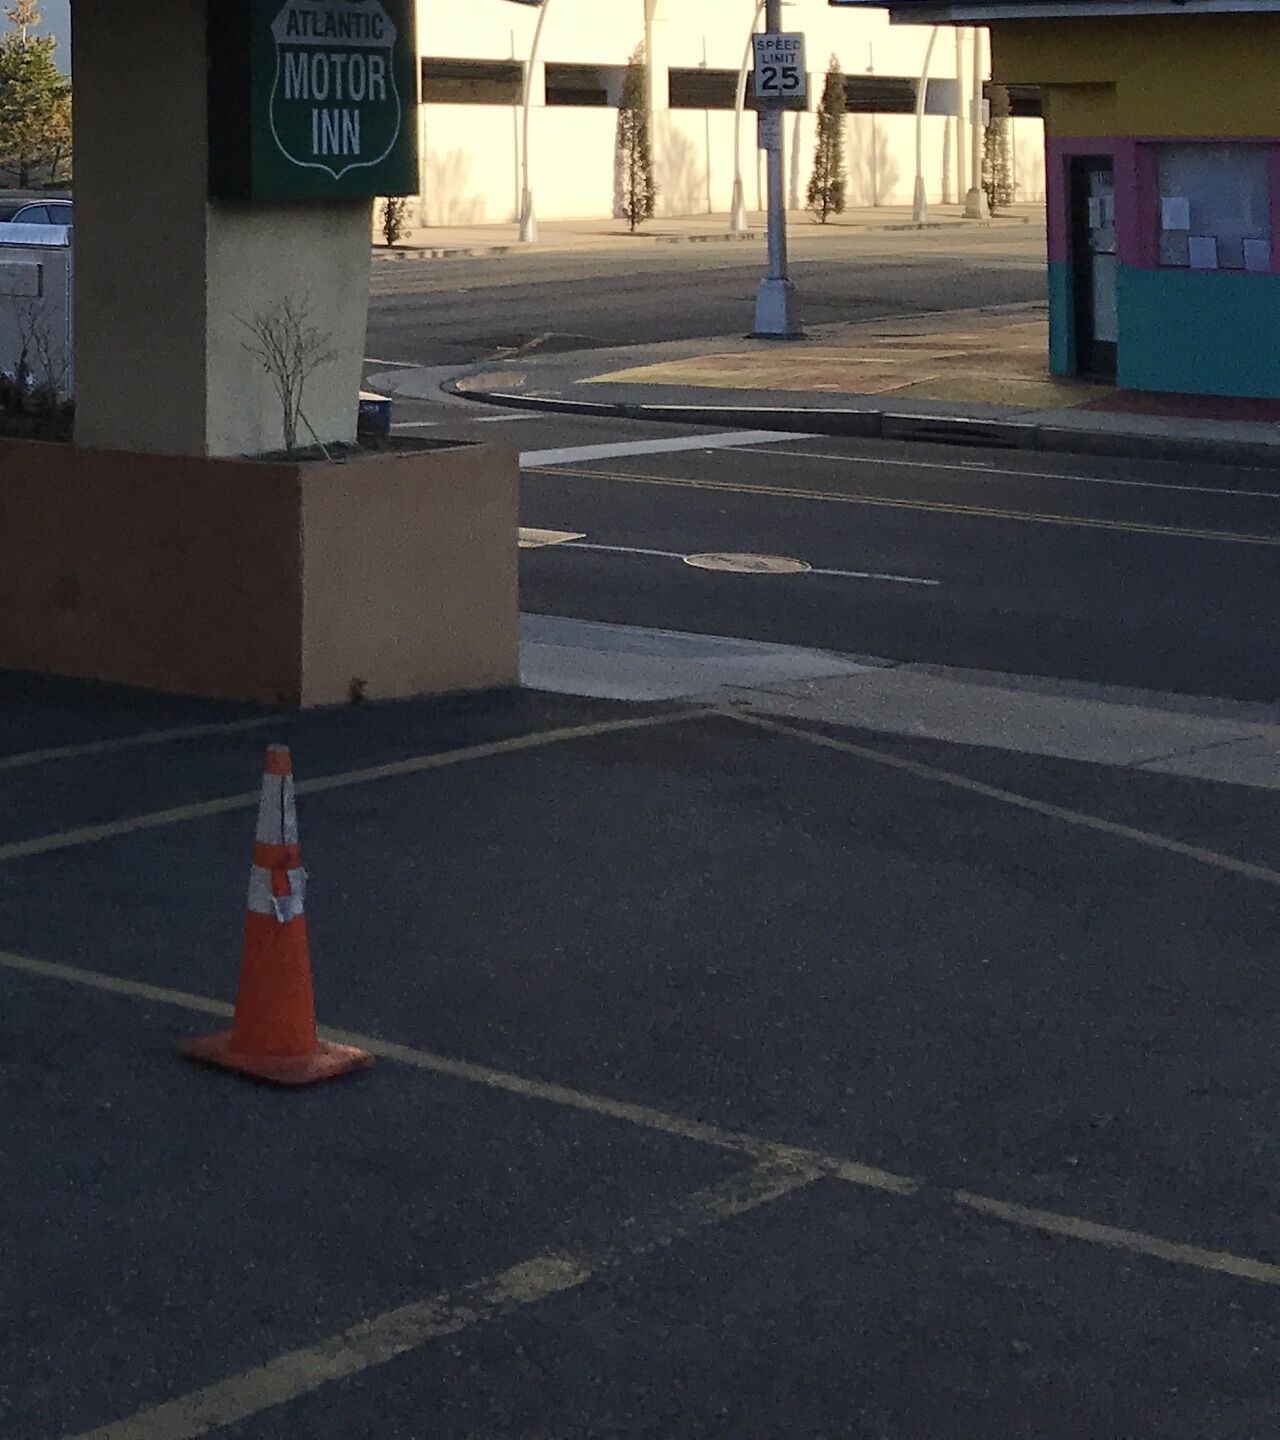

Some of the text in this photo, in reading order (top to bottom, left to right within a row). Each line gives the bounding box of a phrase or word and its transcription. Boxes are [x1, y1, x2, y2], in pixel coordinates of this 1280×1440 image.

[285, 9, 385, 41] ATLANTIC
[756, 40, 801, 51] SPEED
[762, 53, 797, 64] LIMIT
[284, 51, 387, 102] MOTOR
[761, 66, 801, 90] 25
[311, 107, 361, 156] INN
